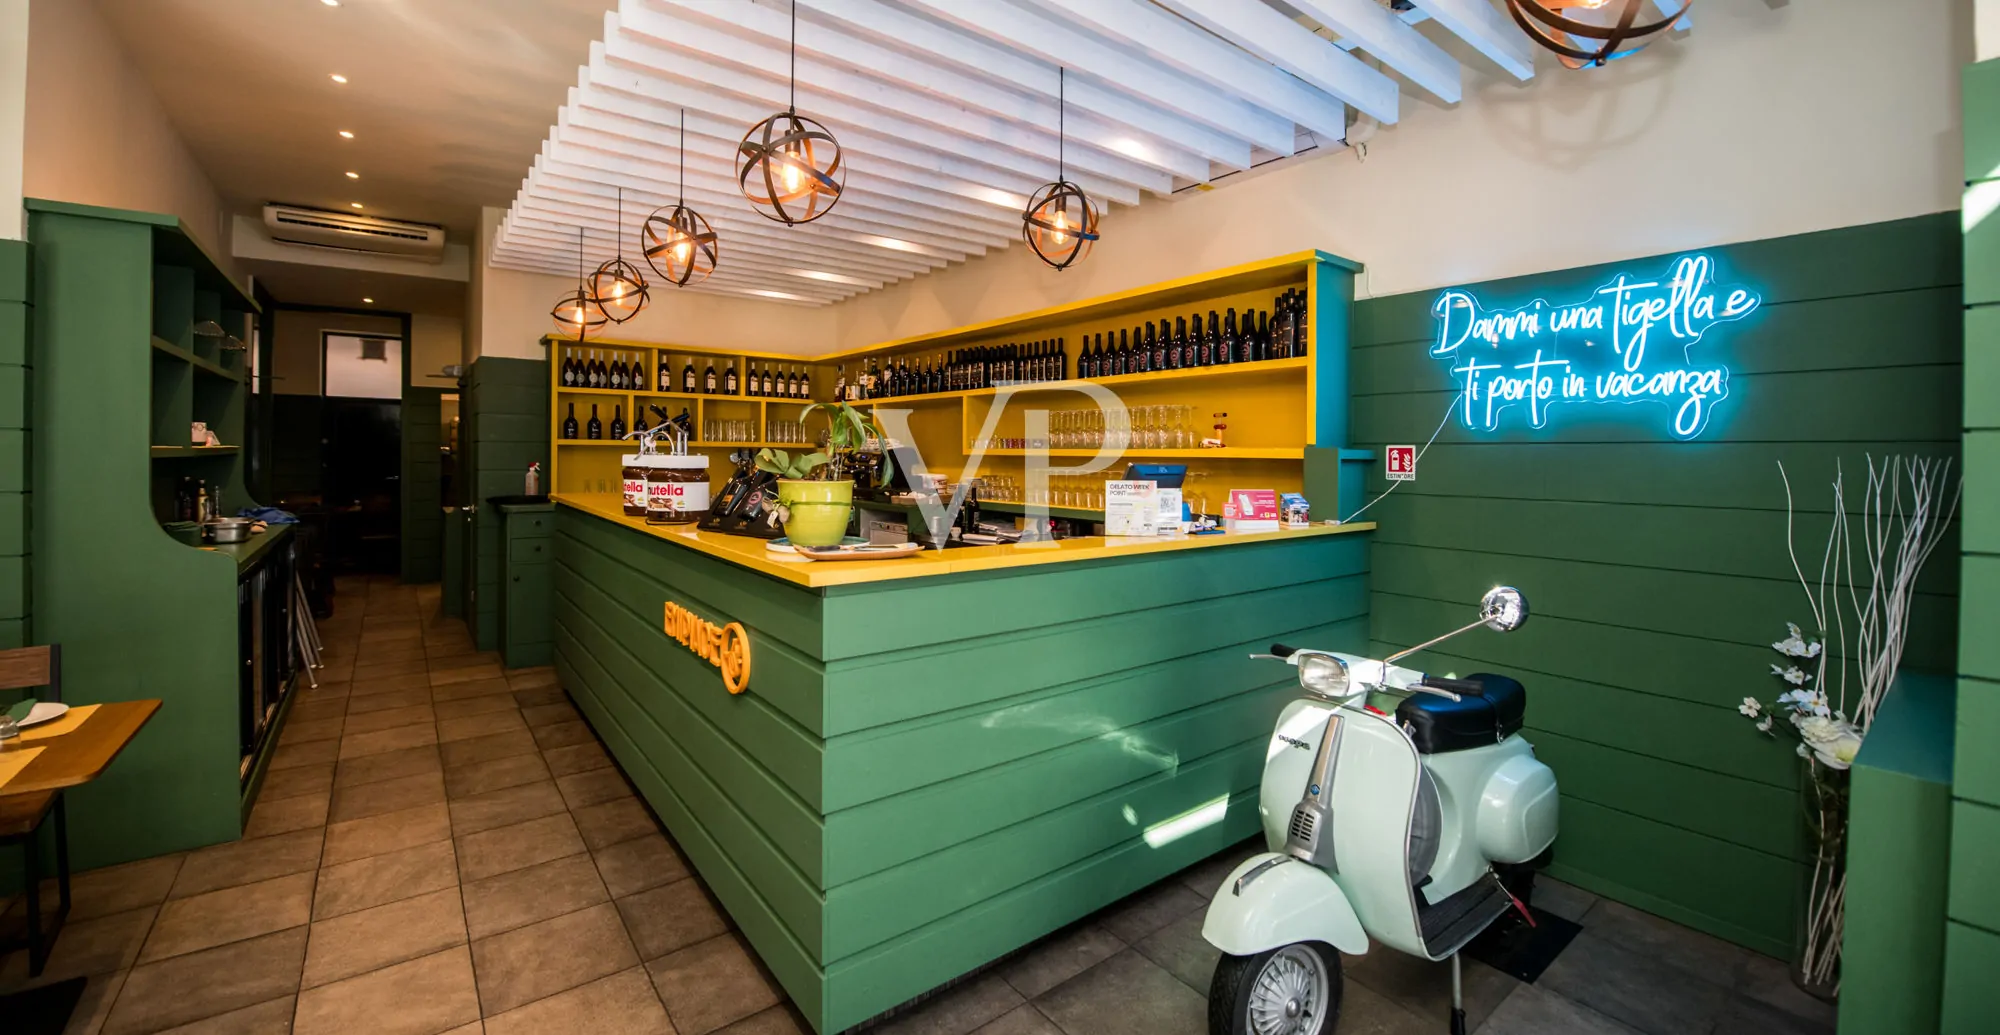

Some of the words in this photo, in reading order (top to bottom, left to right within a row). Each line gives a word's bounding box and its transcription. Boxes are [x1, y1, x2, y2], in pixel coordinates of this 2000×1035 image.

[1433, 293, 1540, 354] Dammi
[1549, 307, 1603, 333] una
[1726, 288, 1756, 315] e
[1485, 348, 1570, 427] porto
[1562, 364, 1586, 398] in
[1595, 368, 1724, 436] vacanza
